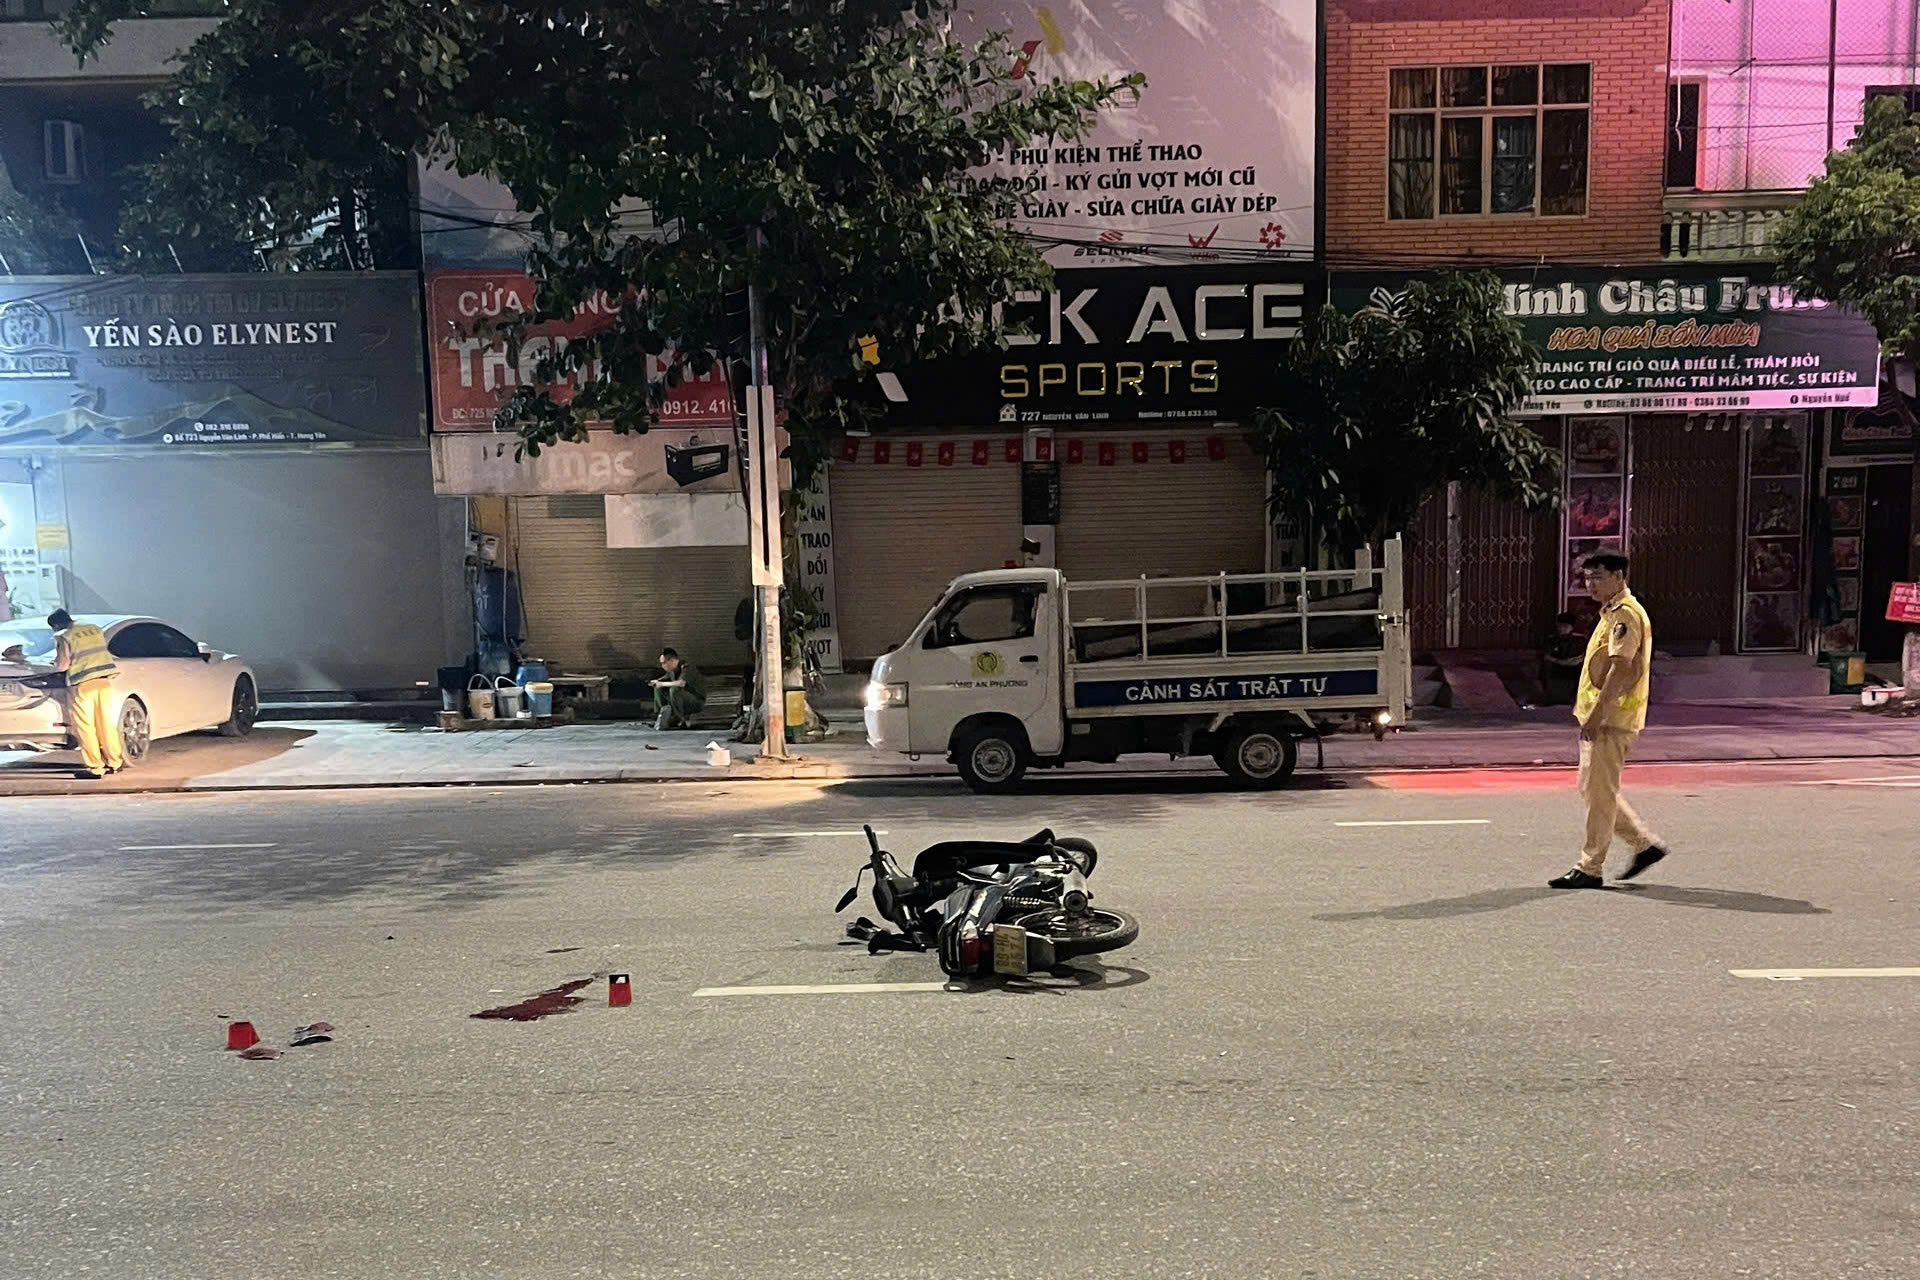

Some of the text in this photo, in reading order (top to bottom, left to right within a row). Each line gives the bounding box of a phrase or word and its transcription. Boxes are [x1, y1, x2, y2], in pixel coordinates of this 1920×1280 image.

[1010, 148, 1049, 168] PHỤ
[1054, 145, 1101, 167] KIỆN
[1106, 139, 1143, 162] THỂ
[1148, 144, 1203, 161] THAO
[1011, 169, 1048, 191] ĐỔI
[1065, 170, 1092, 191] KÝ
[1097, 168, 1132, 190] GỬI
[1137, 170, 1179, 191] VỢT
[1184, 167, 1223, 187] MỚI
[1229, 166, 1256, 186] CŨ
[1023, 198, 1069, 218] GIÀY
[1087, 196, 1125, 216] SỬA
[1131, 195, 1185, 216] CHỮA
[1191, 193, 1238, 214] GIÀY
[1242, 192, 1278, 213] DÉP
[459, 281, 526, 318] CỬA
[1600, 278, 1707, 314] Châu
[1126, 283, 1305, 344] ACE
[82, 318, 337, 348] YẾN SÀO ELYNEST
[1547, 326, 1600, 351] HOA
[1601, 319, 1657, 352] QUẢ
[1652, 318, 1710, 348] BỐN
[1535, 361, 1585, 373] TRANG
[1588, 358, 1612, 373] TRÍ
[1616, 357, 1644, 371] GIỎ
[1648, 356, 1682, 372] QUÀ
[1000, 359, 1220, 398] SPORTS
[1559, 378, 1591, 390] CAO
[1594, 374, 1624, 389] CẤP
[1636, 376, 1687, 389] TRANG
[1691, 374, 1715, 387] TRÍ
[1718, 373, 1754, 387] MÂM
[1797, 372, 1819, 386] SỰ
[1821, 370, 1857, 386] KIỆN
[1020, 411, 1041, 422] 727
[801, 532, 831, 548] TRAO
[1125, 676, 1328, 701] CẢNH SÁT TRẬT TỰ
